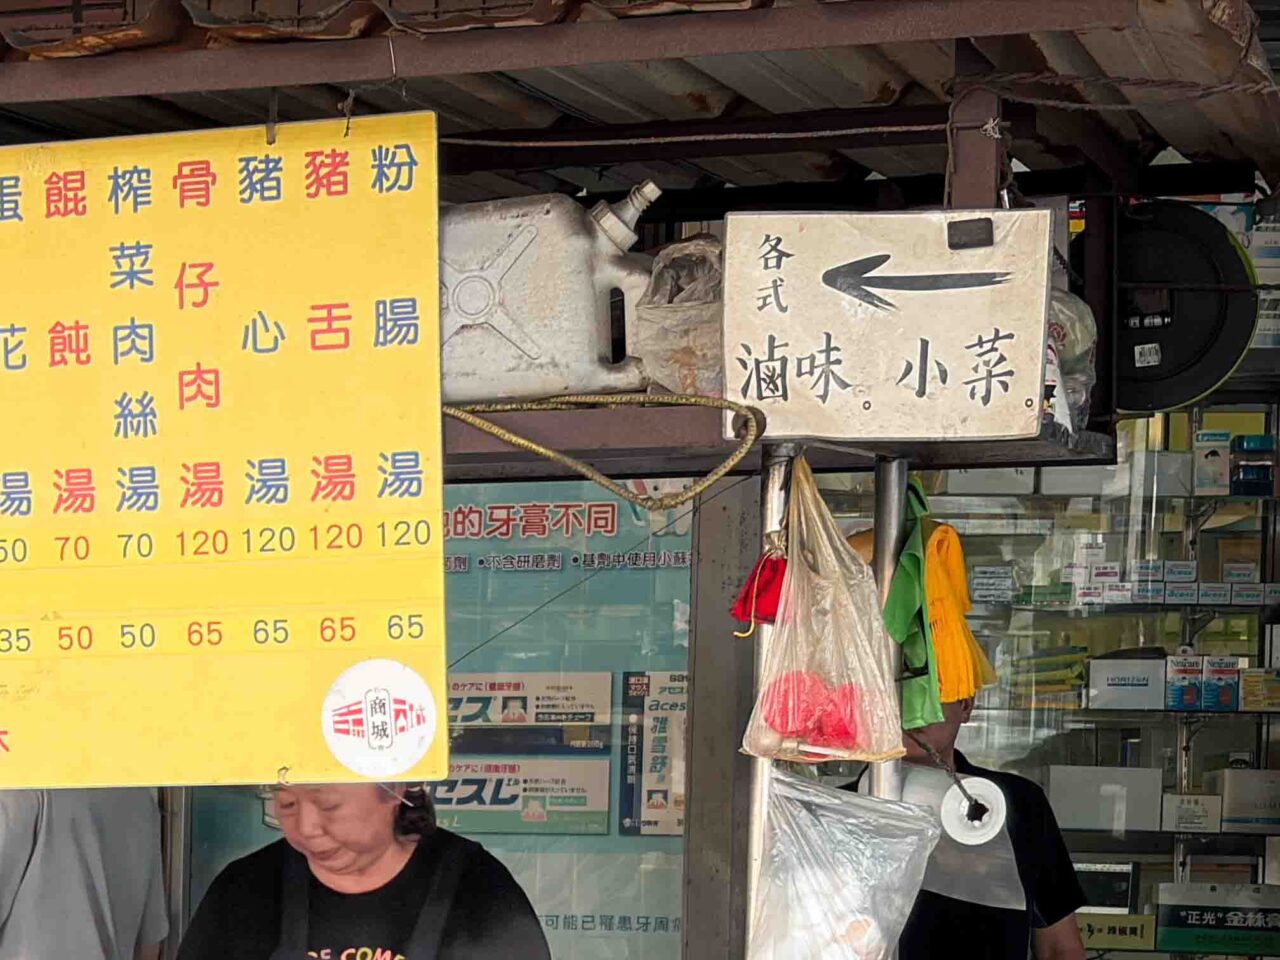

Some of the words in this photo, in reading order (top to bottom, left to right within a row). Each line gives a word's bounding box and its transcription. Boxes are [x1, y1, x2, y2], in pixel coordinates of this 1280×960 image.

[757, 233, 794, 313] 各式
[44, 171, 96, 514] 餛飩湯
[108, 165, 160, 512] 榨菜肉絲湯
[173, 160, 224, 508] 骨仔肉湯
[236, 154, 290, 505] 豬心湯
[304, 147, 357, 502] 豬舌湯
[370, 142, 424, 499] 粉腸湯
[736, 331, 852, 404] 滷味
[896, 327, 1014, 406] 小菜
[55, 536, 89, 560] 70
[117, 533, 152, 558] 70
[177, 530, 228, 556] 120
[243, 527, 295, 554] 120
[310, 523, 362, 550] 120
[377, 520, 430, 547] 120
[488, 553, 561, 570] 不含研磨劑
[582, 551, 692, 568] 基劑中使用小蘇
[59, 626, 92, 650] 50
[121, 623, 156, 648] 50
[188, 621, 222, 646] 65
[254, 620, 288, 644] 65
[320, 617, 356, 642] 65
[388, 614, 423, 640] 65
[1171, 660, 1200, 668] Nexcare
[1207, 660, 1237, 669] Nexcare
[368, 696, 389, 741] 商城
[648, 699, 687, 712] aces
[538, 914, 681, 933] 可能已罹患牙周
